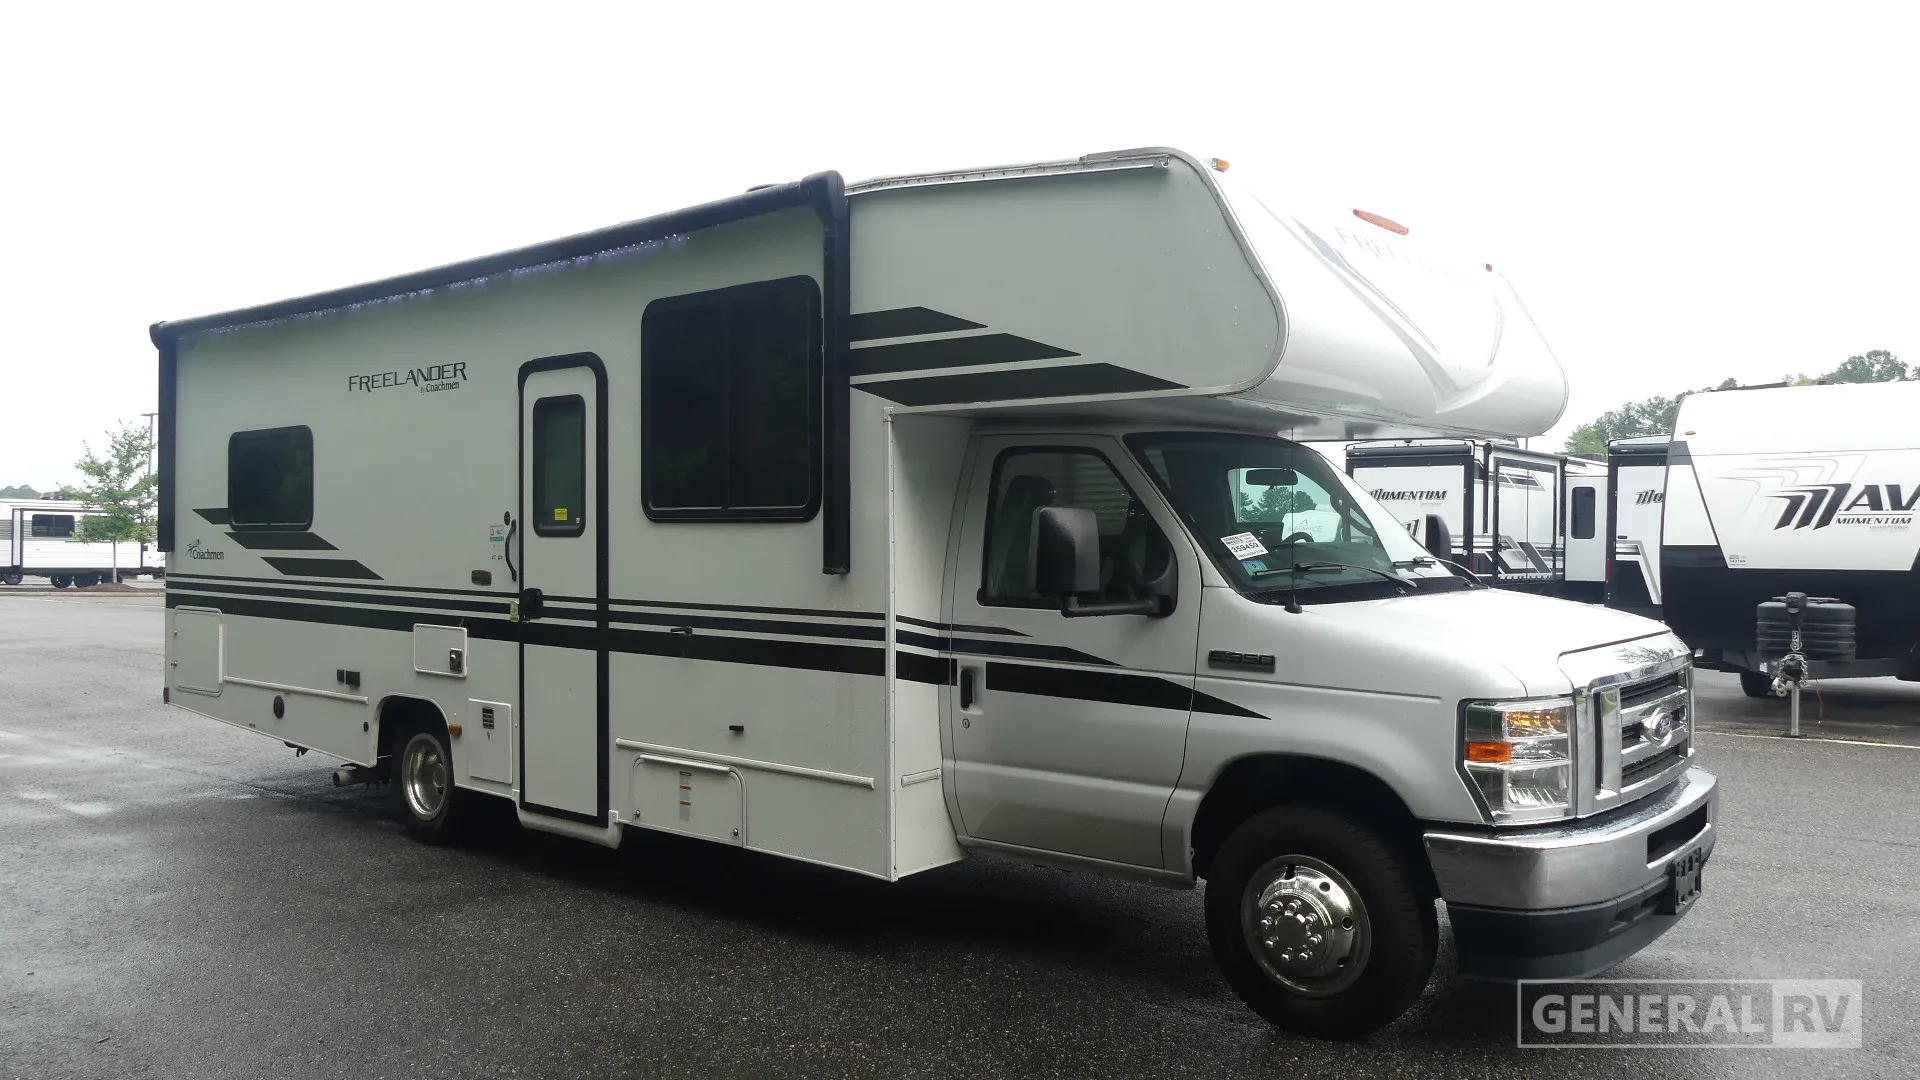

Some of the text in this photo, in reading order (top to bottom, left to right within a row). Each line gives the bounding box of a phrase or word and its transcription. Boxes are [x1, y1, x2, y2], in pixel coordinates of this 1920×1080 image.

[348, 361, 467, 393] FREELANDER
[426, 381, 460, 393] Coachmen
[1836, 517, 1912, 525] MOMENTUM
[1231, 542, 1260, 553] 359450
[193, 549, 224, 560] Coachmen
